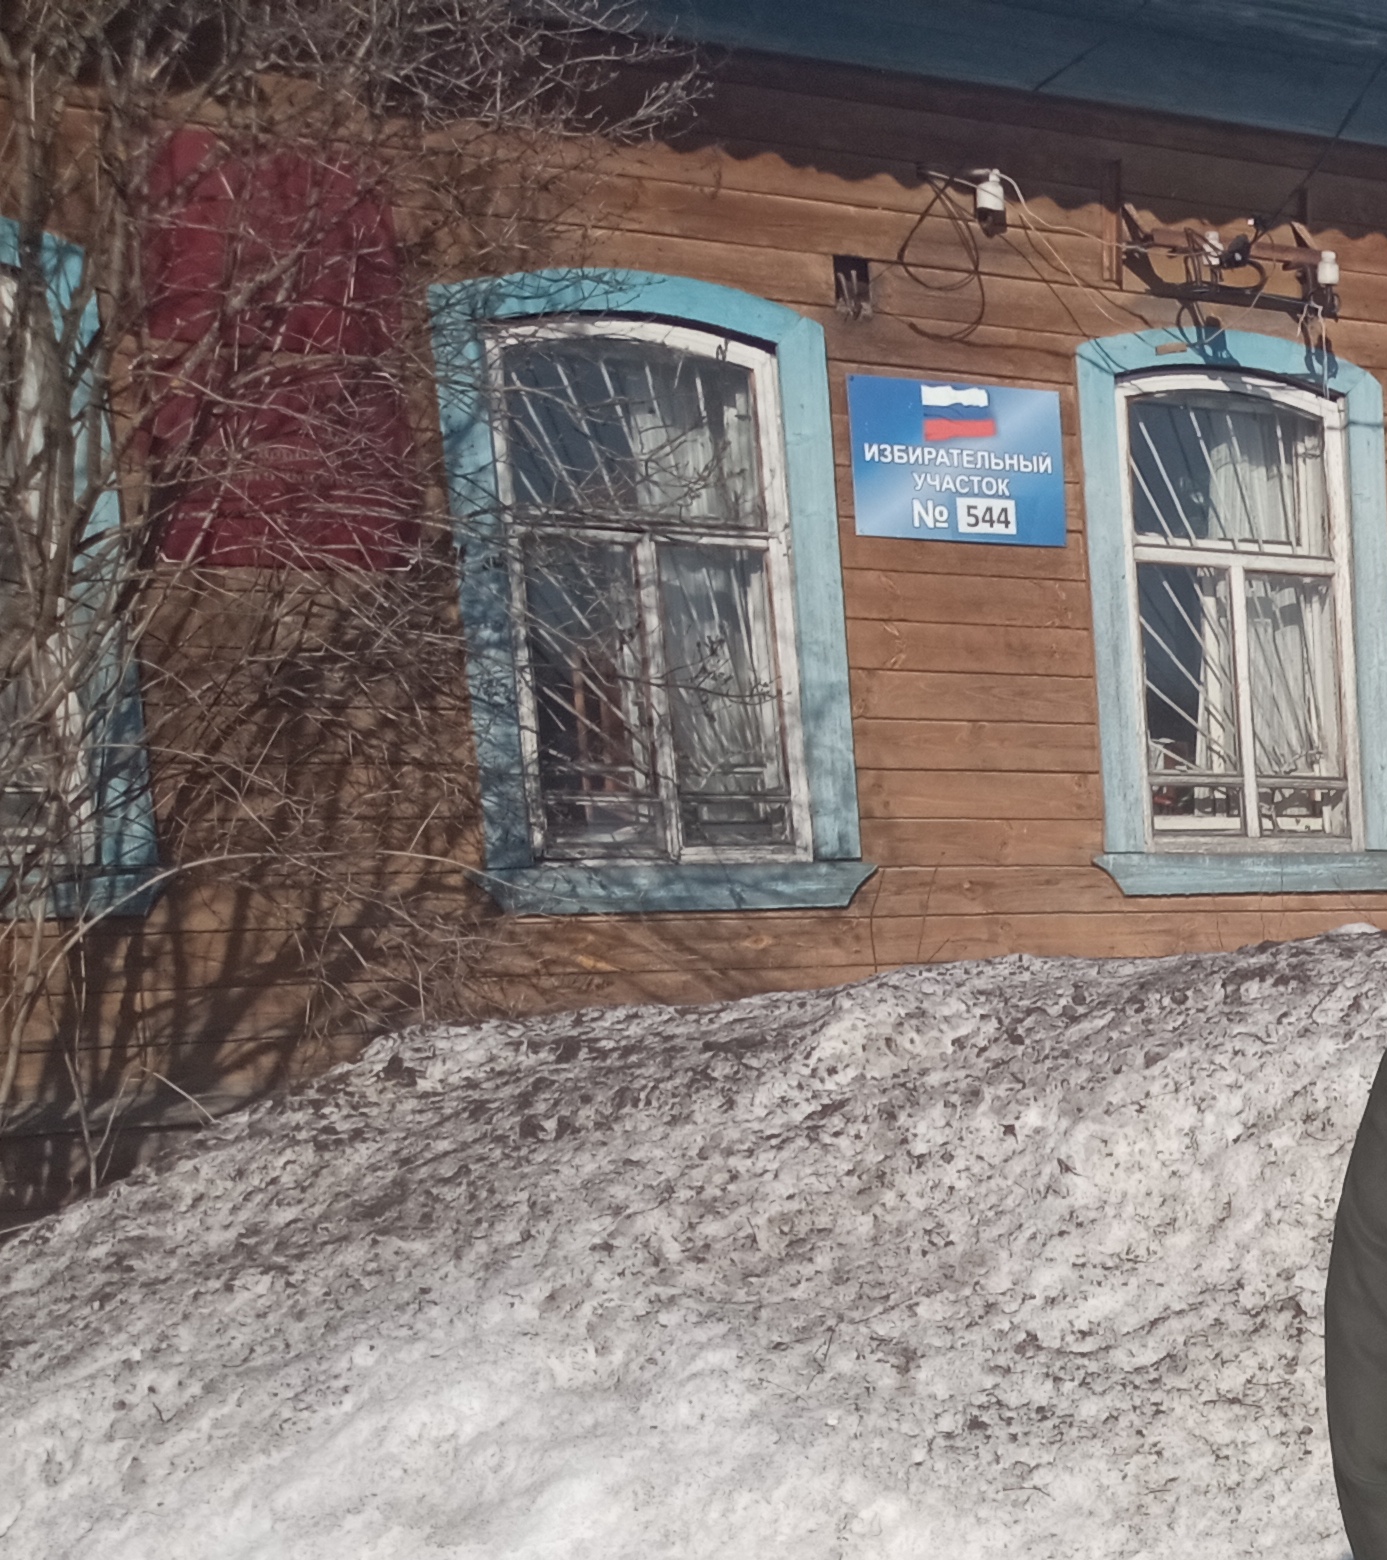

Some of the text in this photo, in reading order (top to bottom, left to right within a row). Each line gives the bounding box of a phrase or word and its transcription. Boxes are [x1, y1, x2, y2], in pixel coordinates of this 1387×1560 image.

[863, 443, 1052, 474] ИЗБИРАТЕЛЬНЫЙ
[913, 472, 1011, 497] УЧАСТОК
[912, 499, 1011, 529] № 544
